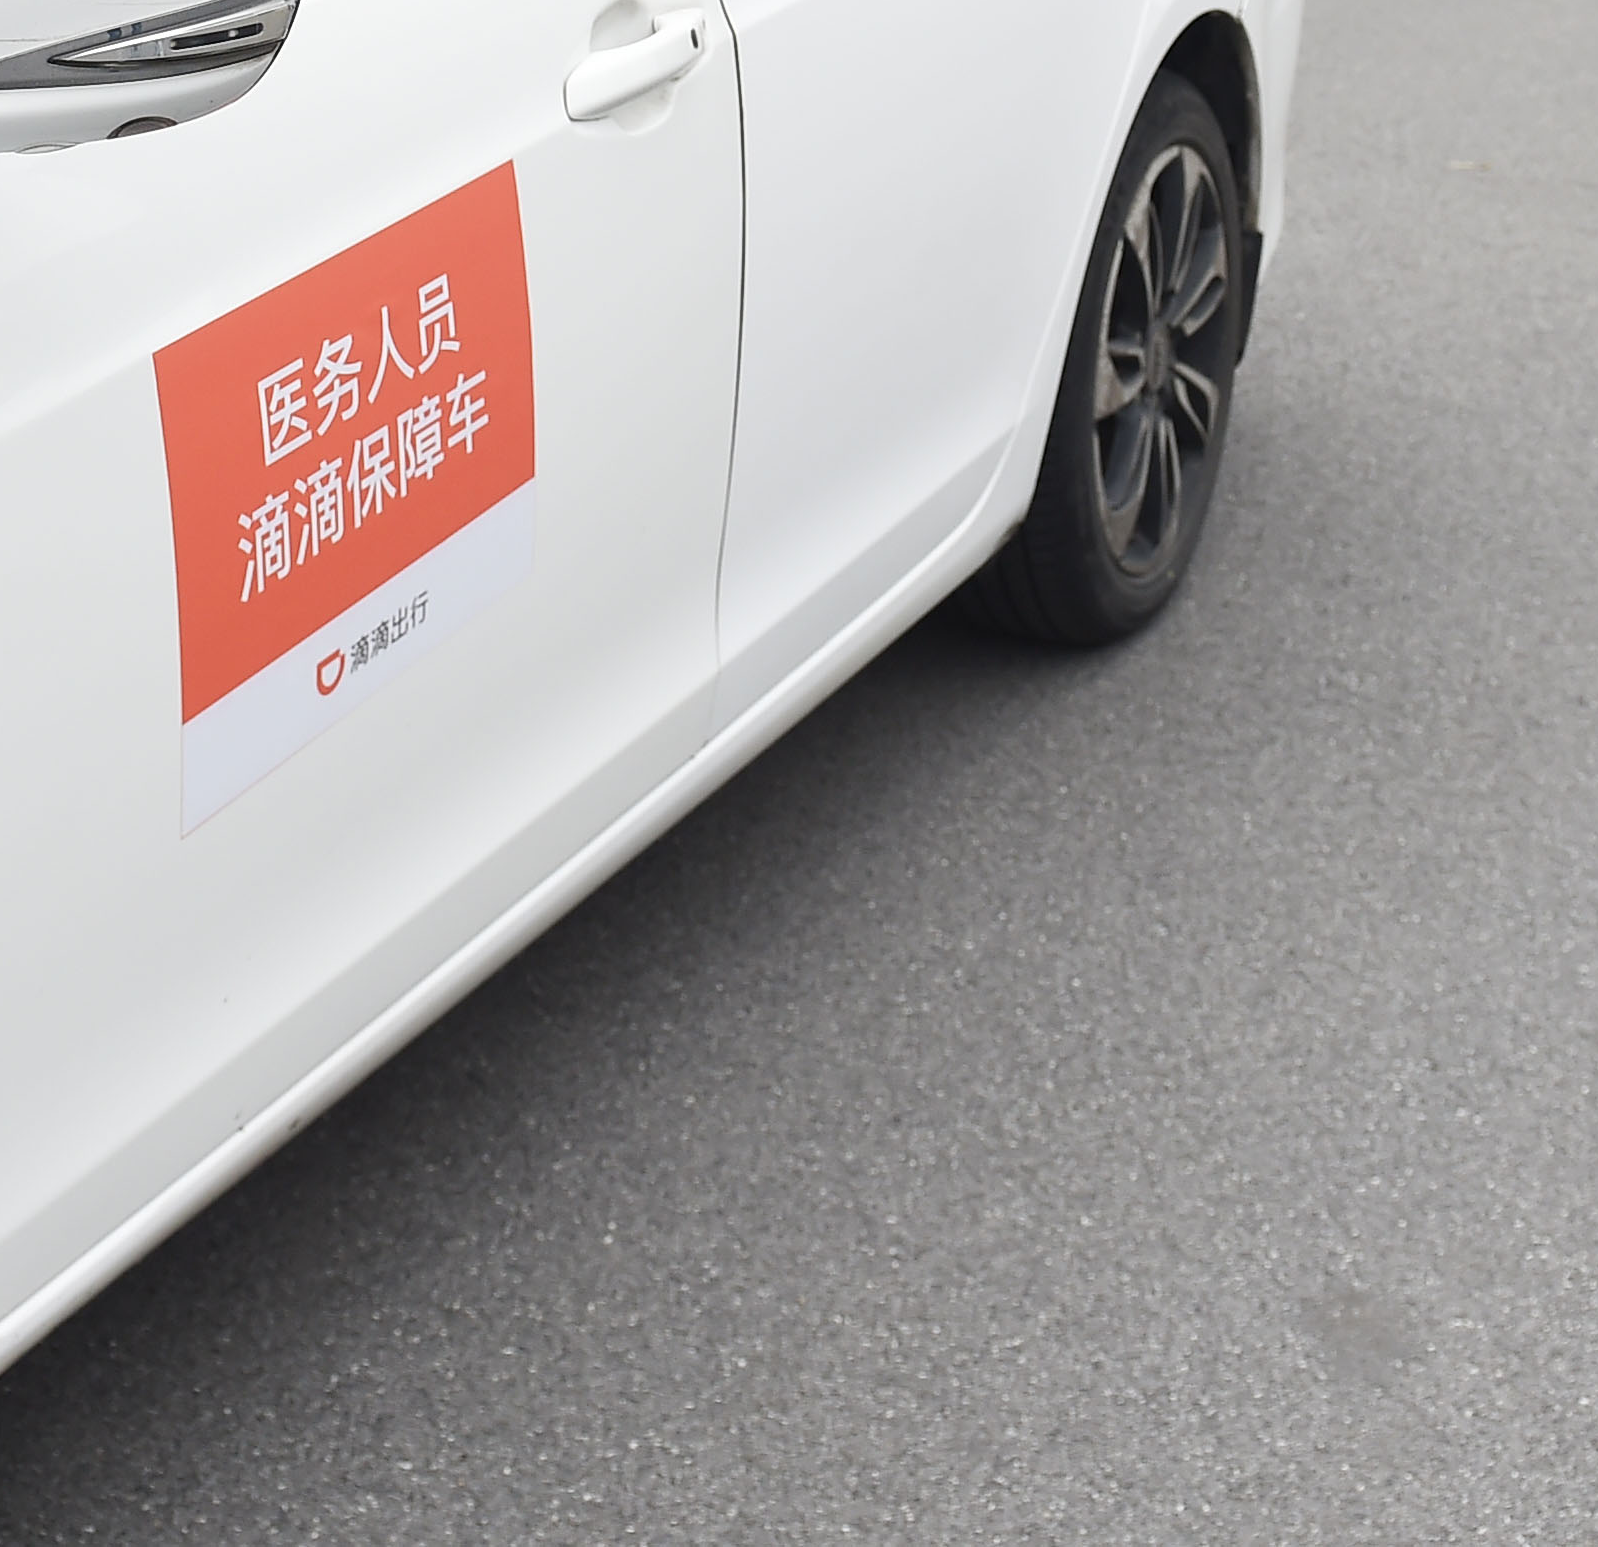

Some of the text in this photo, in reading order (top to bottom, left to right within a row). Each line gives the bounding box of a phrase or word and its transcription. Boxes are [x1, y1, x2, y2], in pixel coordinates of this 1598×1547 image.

[256, 272, 461, 468] 医务人员
[235, 368, 491, 604] 滴滴保障车
[349, 590, 429, 675] 滴滴出行
